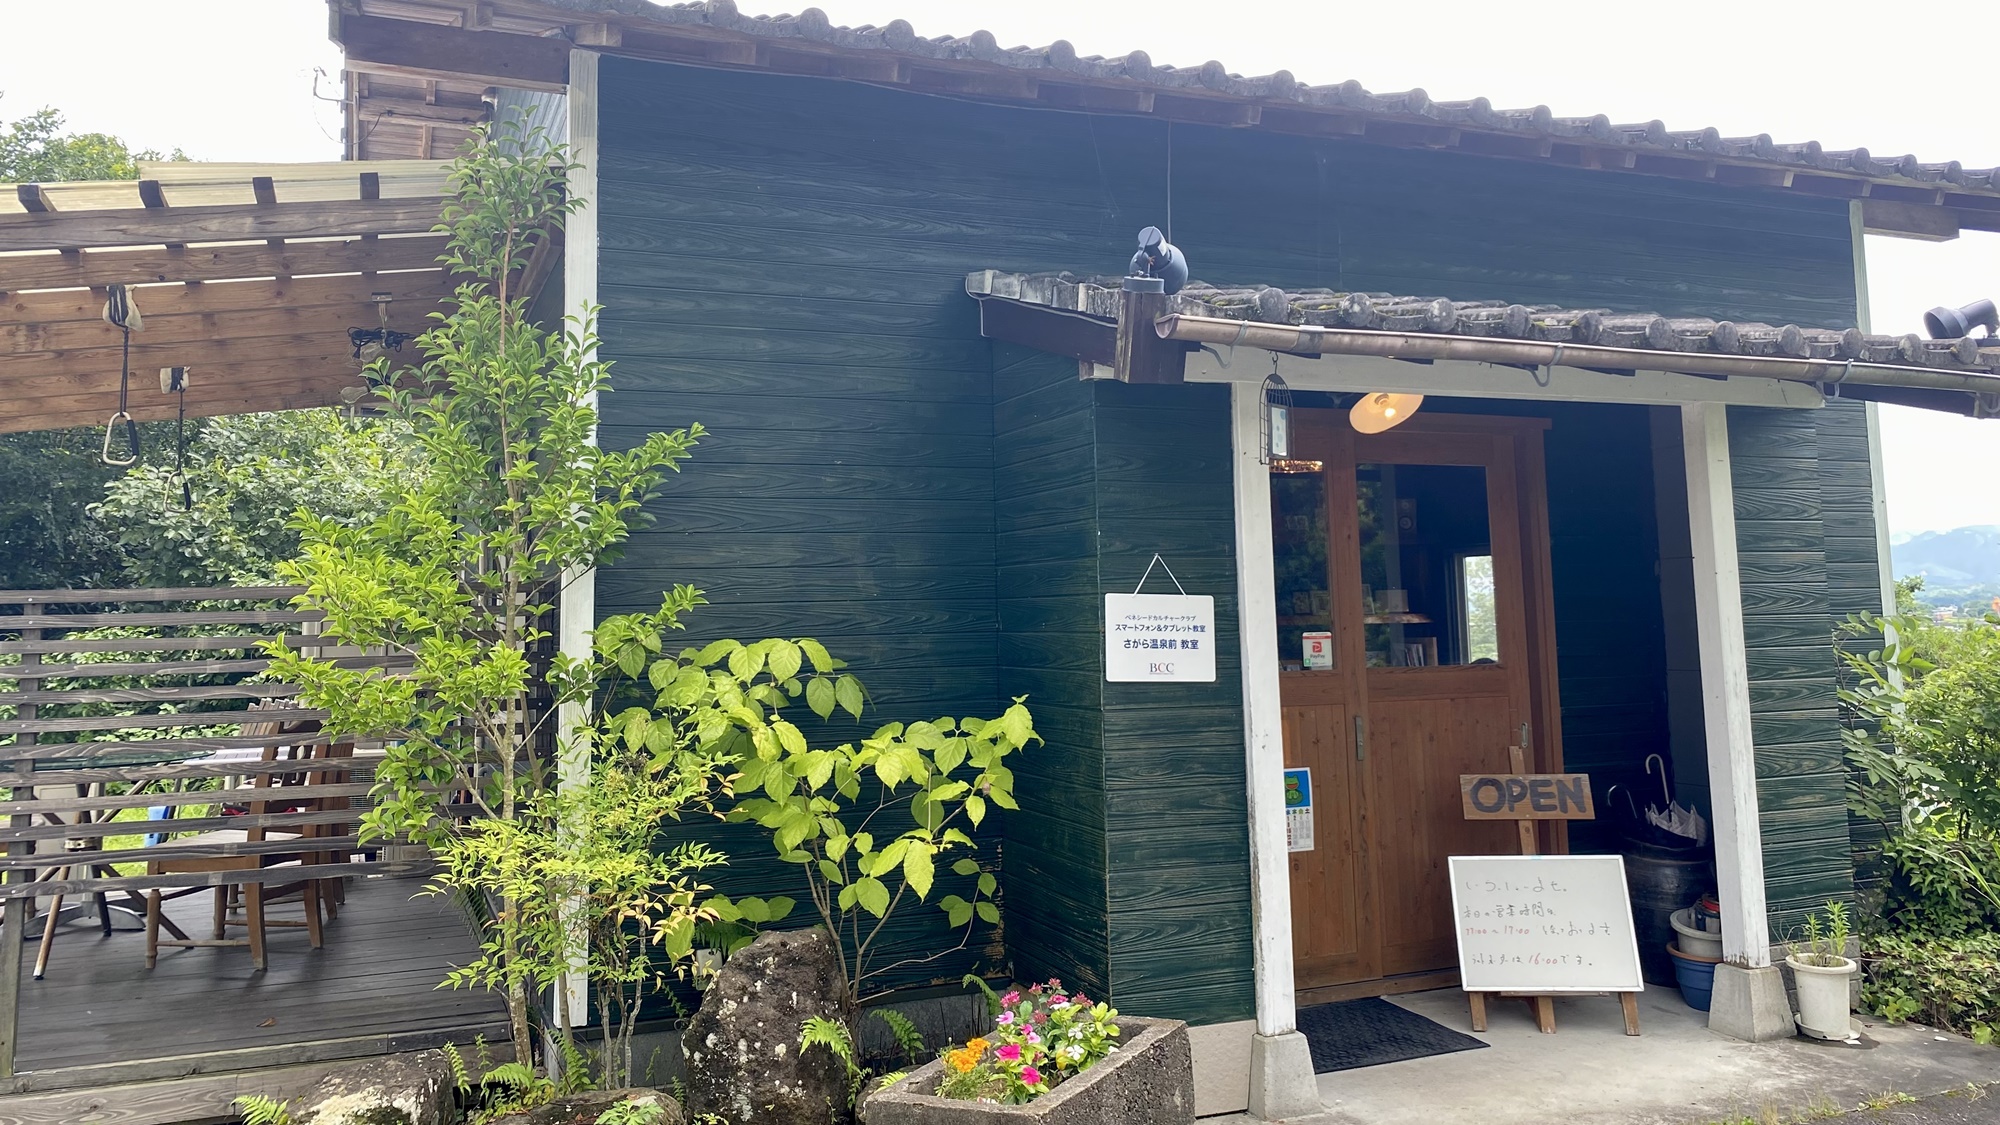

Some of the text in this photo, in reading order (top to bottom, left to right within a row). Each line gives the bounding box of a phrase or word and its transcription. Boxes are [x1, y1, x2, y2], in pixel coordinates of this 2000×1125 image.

[1123, 638, 1199, 650] さがら温泉前 教室
[1149, 662, 1174, 673] BCC
[1470, 777, 1586, 813] OPEN
